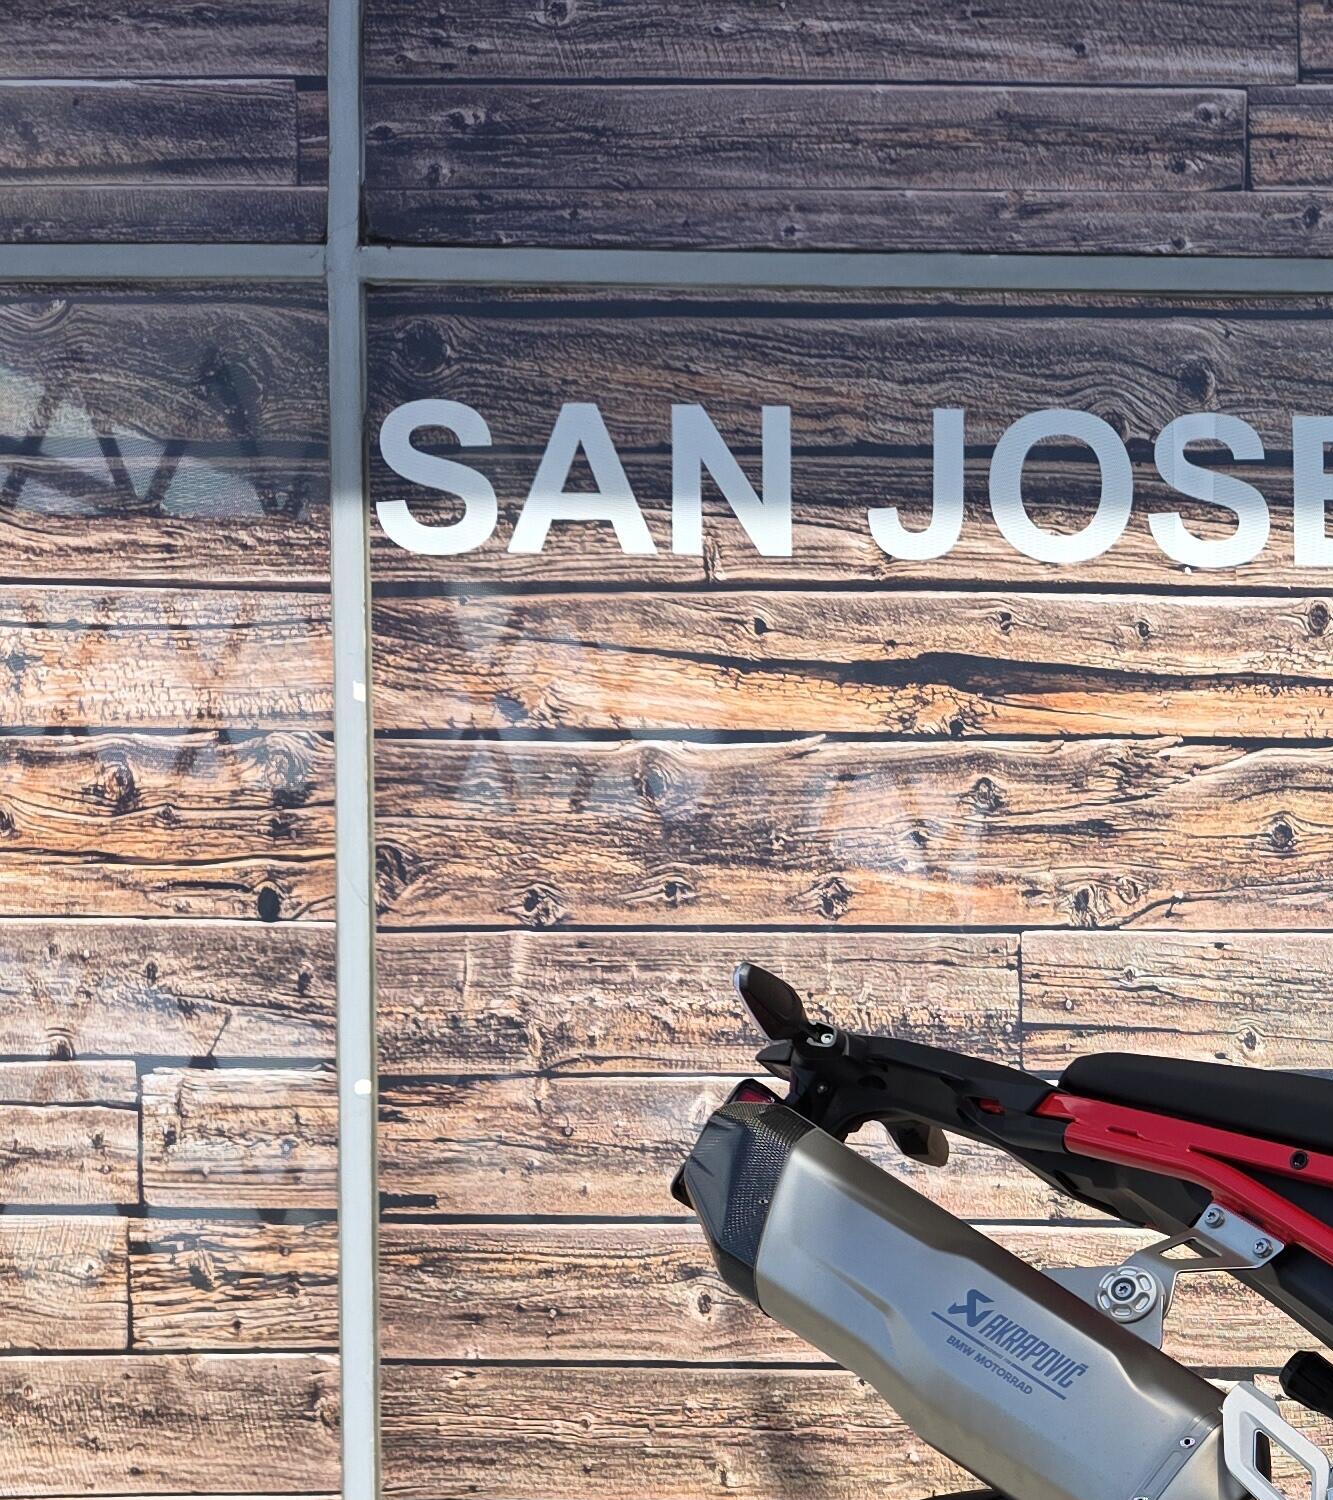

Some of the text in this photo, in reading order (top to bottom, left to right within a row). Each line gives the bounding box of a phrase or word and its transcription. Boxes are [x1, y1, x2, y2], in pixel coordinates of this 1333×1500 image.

[376, 398, 793, 558] SAN
[946, 1335, 975, 1358] BMW
[974, 1356, 1033, 1395] MOTORRAD
